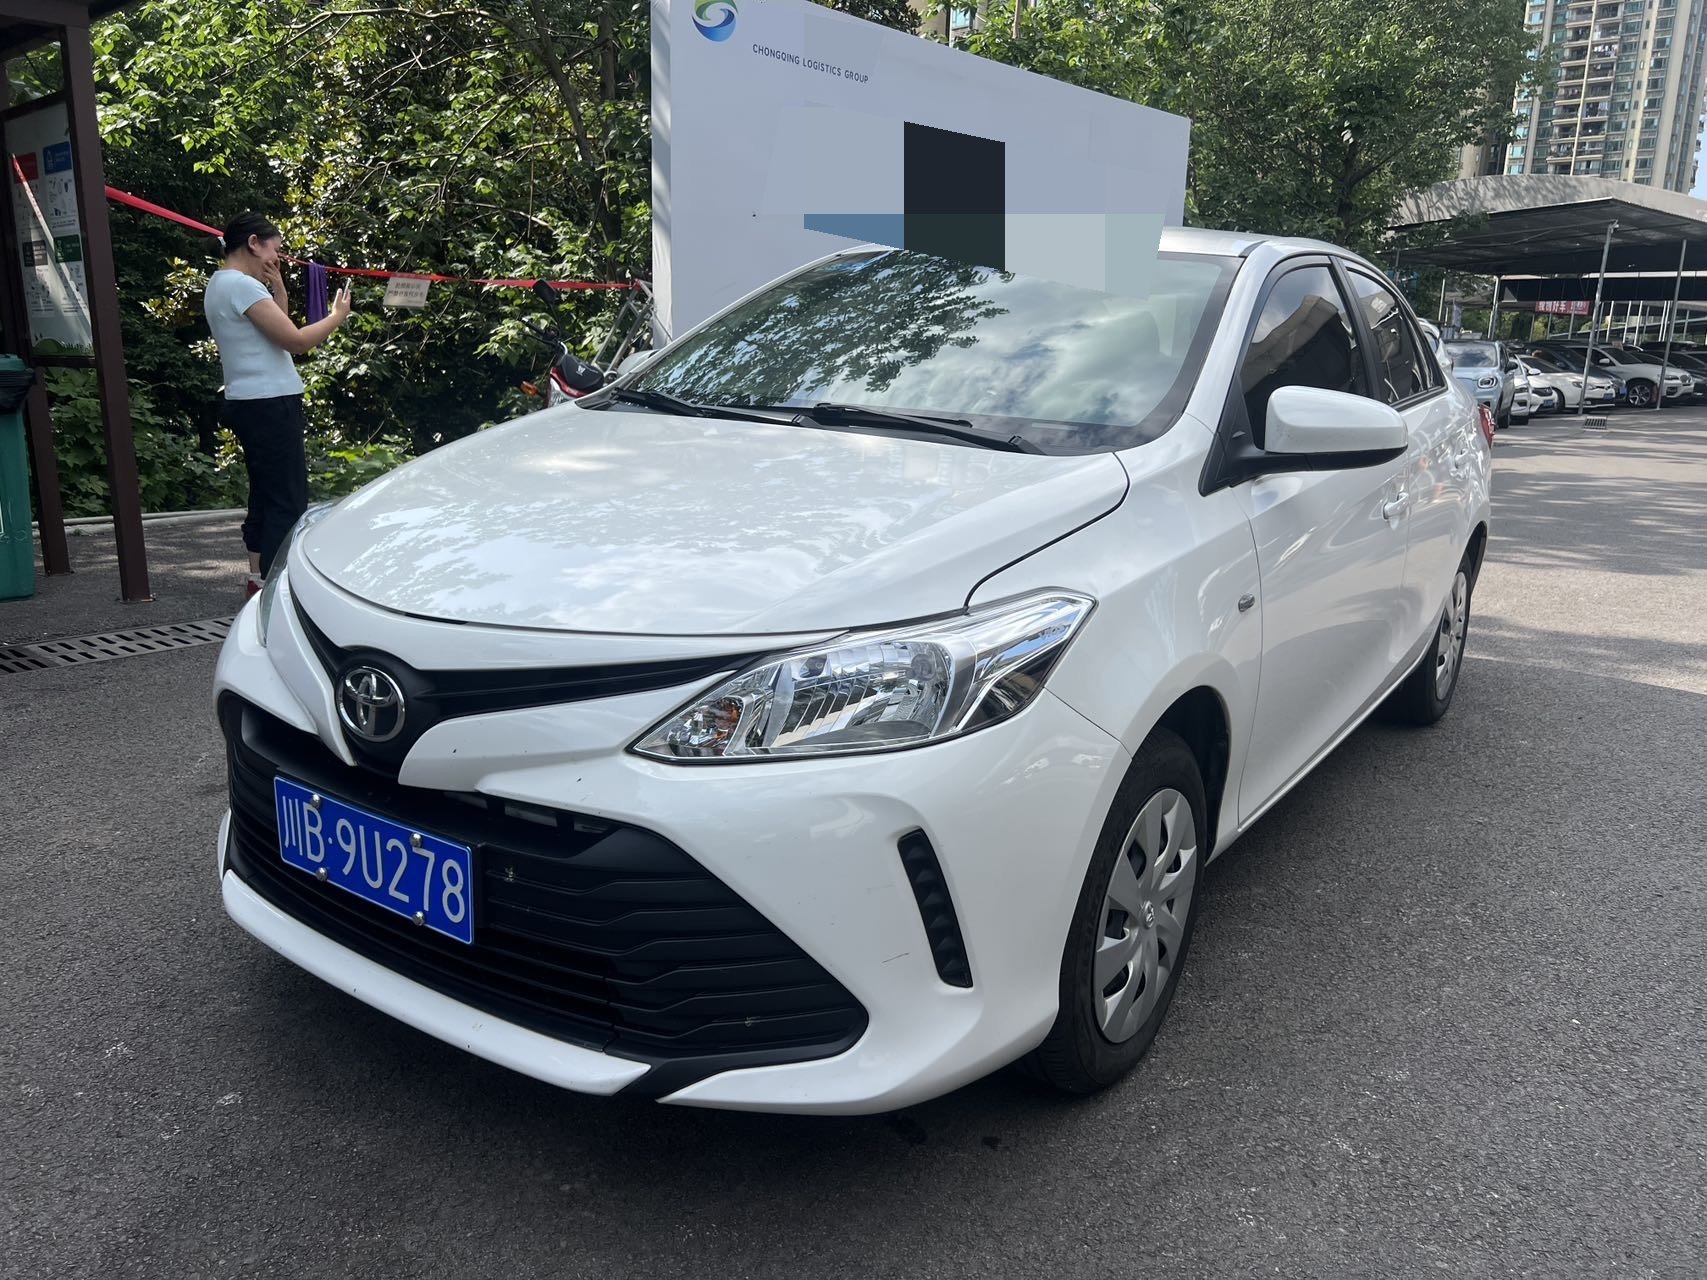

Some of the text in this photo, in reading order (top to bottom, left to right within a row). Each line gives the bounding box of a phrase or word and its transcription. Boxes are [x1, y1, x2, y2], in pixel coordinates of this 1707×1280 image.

[752, 44, 869, 84] CHONGQING LOGISTICS GROUP
